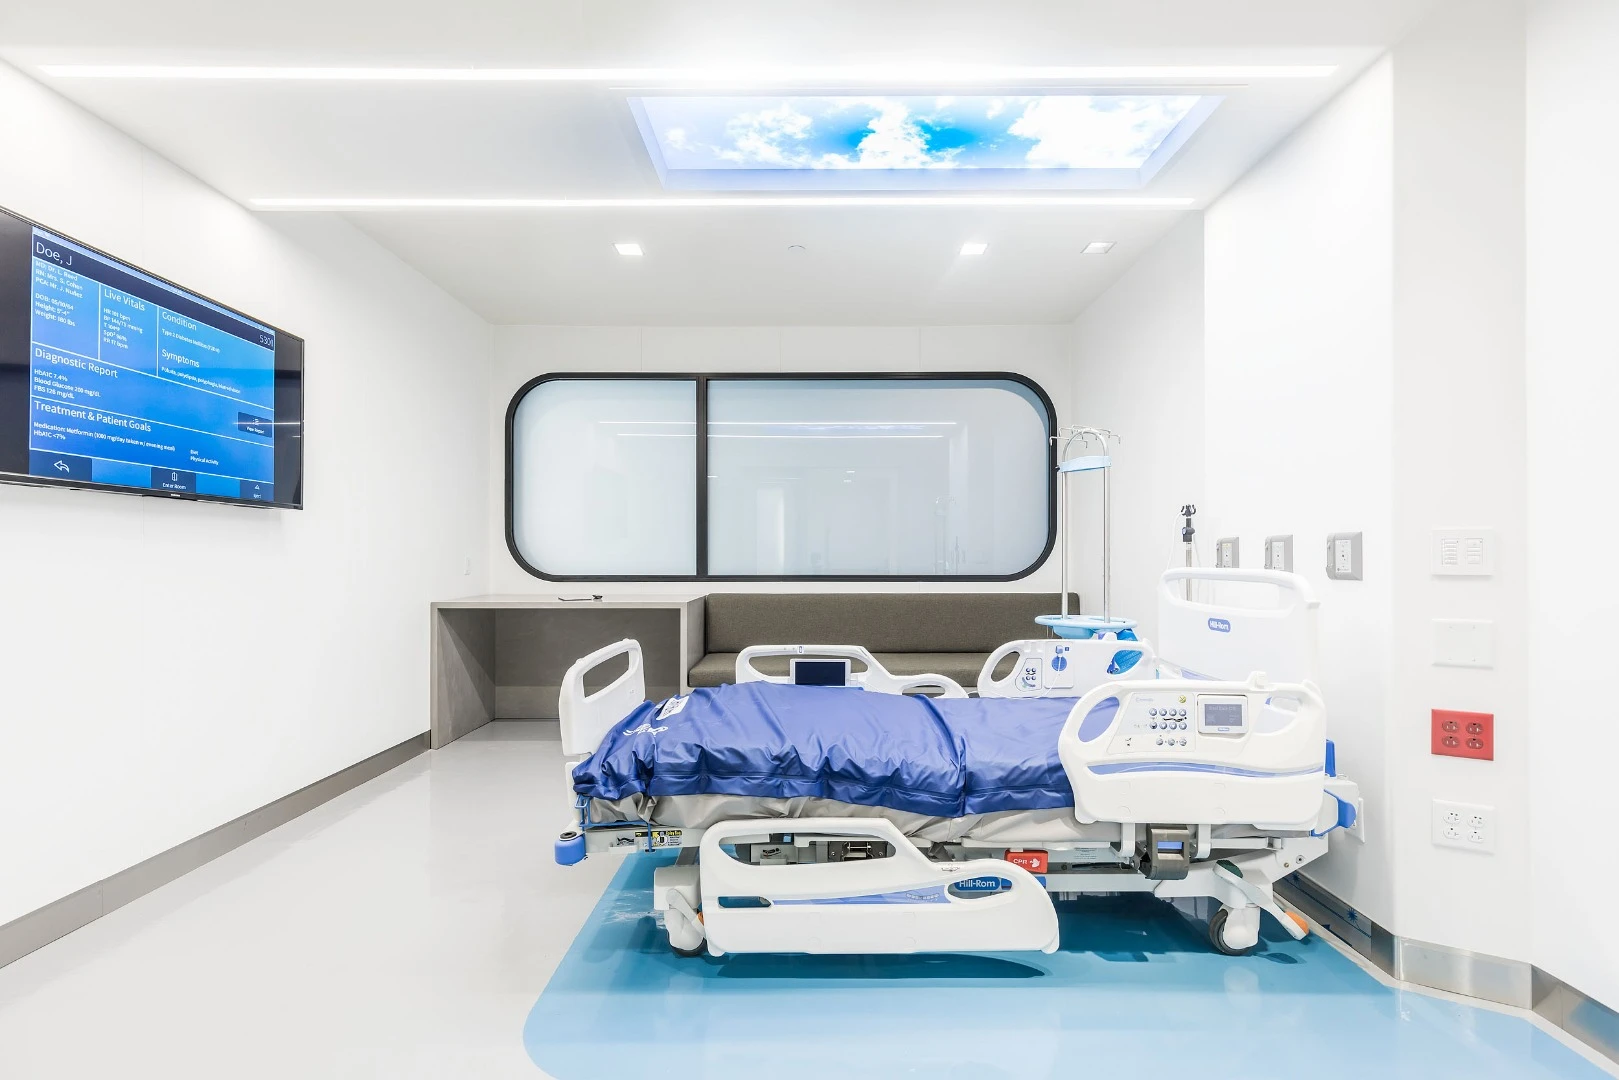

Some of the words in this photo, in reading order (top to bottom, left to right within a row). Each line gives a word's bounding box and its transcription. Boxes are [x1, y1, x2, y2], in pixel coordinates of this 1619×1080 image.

[36, 242, 62, 264] Doe,
[65, 255, 72, 265] J
[36, 269, 46, 277] RN:
[64, 272, 77, 280] Reed
[36, 293, 50, 302] DOB:
[104, 289, 121, 302] Live
[123, 296, 145, 311] Vitals
[36, 301, 56, 313] Height:
[35, 309, 56, 321] Weight:
[162, 311, 197, 331] Condition
[35, 348, 87, 369] Diagnostic
[88, 363, 118, 378] Report
[162, 349, 200, 368] Symptoms
[34, 377, 51, 386] Blood
[52, 381, 73, 391] Glucose
[57, 390, 75, 399] mg/dL
[34, 401, 86, 419] Treatment
[88, 411, 95, 421] &
[97, 413, 127, 427] Patient
[129, 420, 151, 432] Goals
[34, 421, 65, 432] Medication:
[190, 456, 206, 464] Physical
[1209, 620, 1229, 631] Hill-Rom
[960, 879, 996, 889] Hill-Rom
